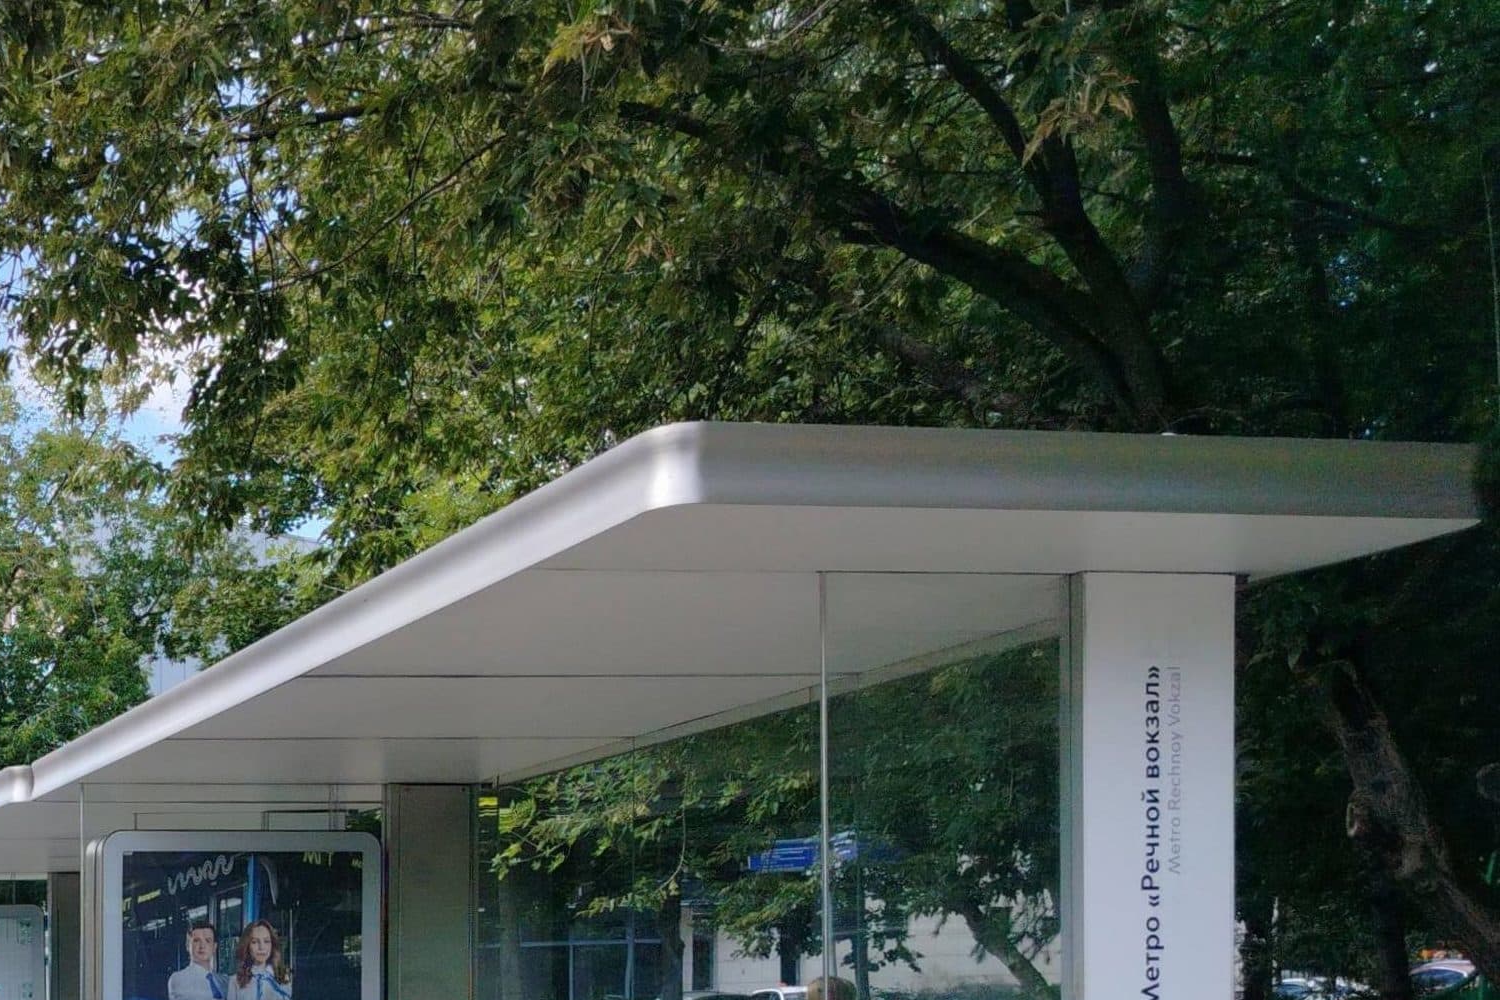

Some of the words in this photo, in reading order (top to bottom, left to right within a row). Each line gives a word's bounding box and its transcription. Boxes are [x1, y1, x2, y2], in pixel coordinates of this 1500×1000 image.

[1145, 665, 1161, 778] вокзал»
[1166, 666, 1181, 727] Vokzal
[1167, 729, 1184, 811] Rechnoy
[1140, 789, 1160, 907] «Речной
[1168, 817, 1181, 875] Metro
